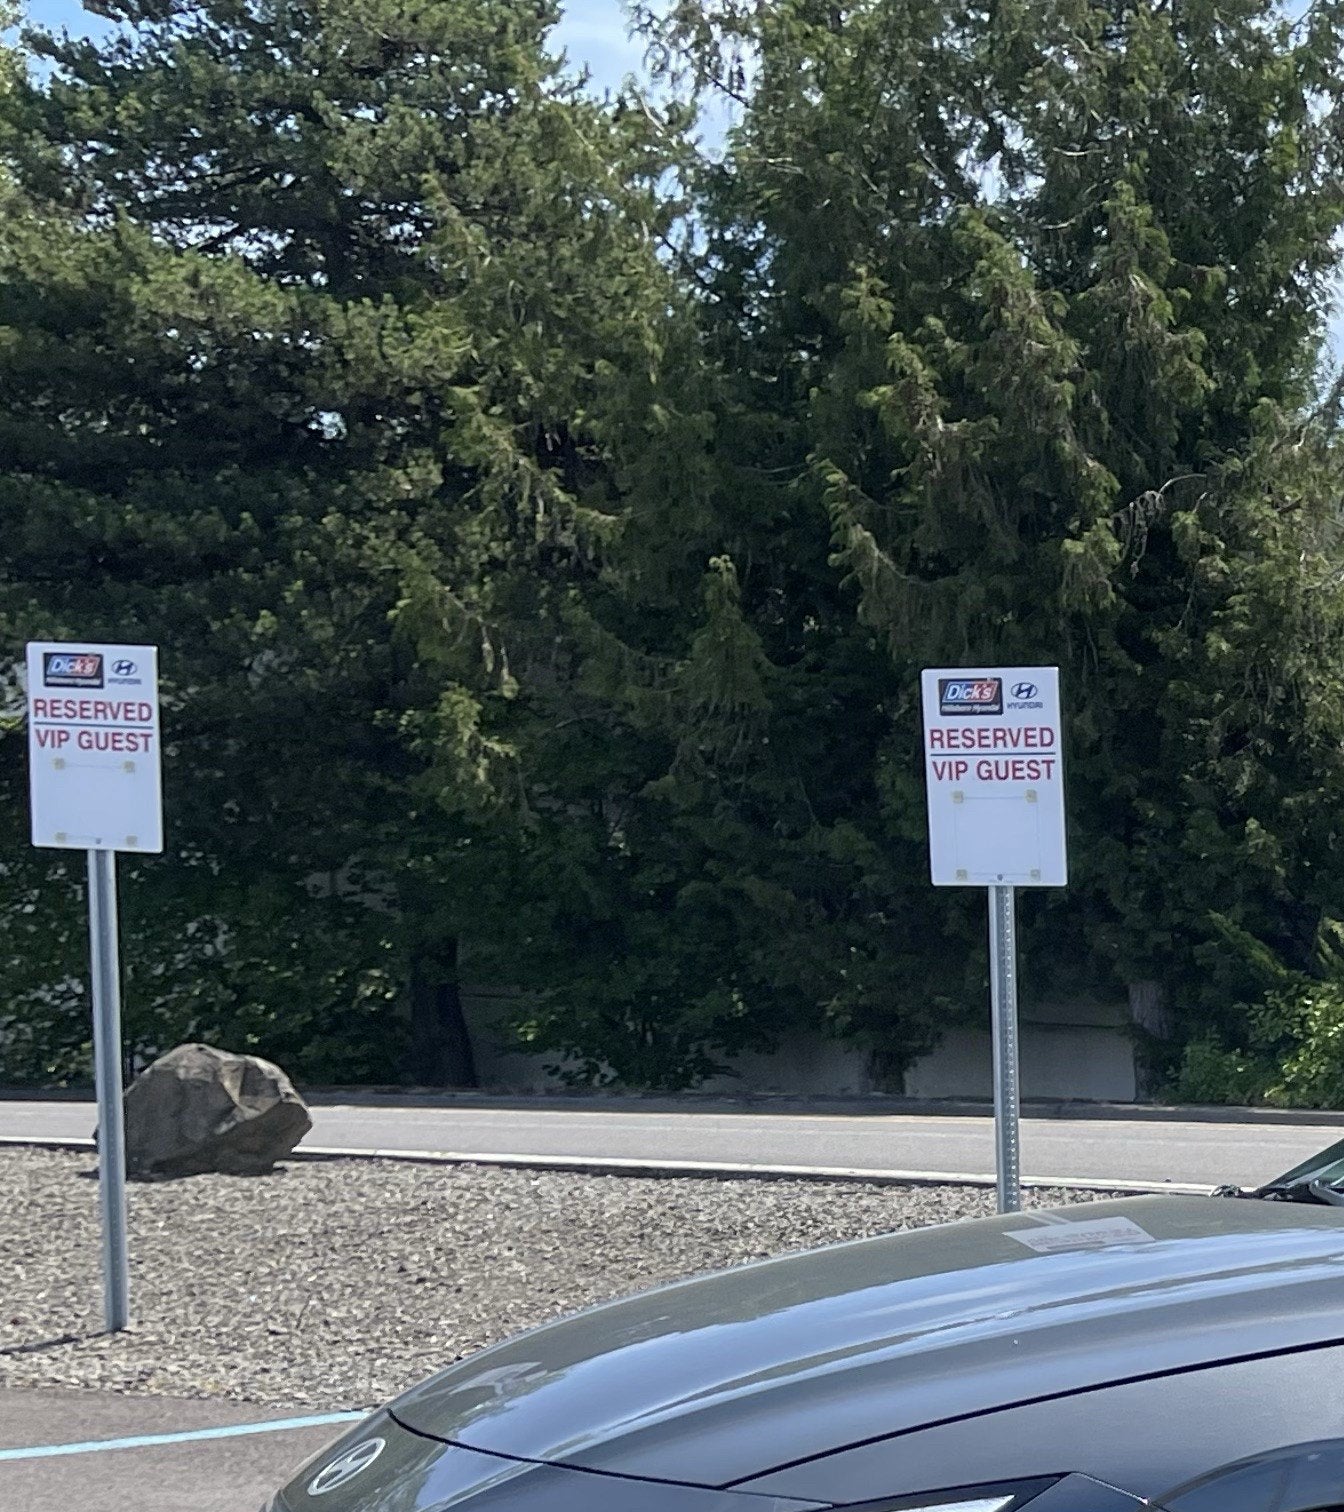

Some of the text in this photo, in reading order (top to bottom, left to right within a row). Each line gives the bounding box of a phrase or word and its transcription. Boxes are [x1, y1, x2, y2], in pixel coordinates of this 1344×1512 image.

[33, 699, 152, 722] RESERVED
[35, 729, 154, 752] VIP GUEST
[929, 727, 1055, 749] RESERVED
[932, 759, 1056, 780] VIP GUEST
